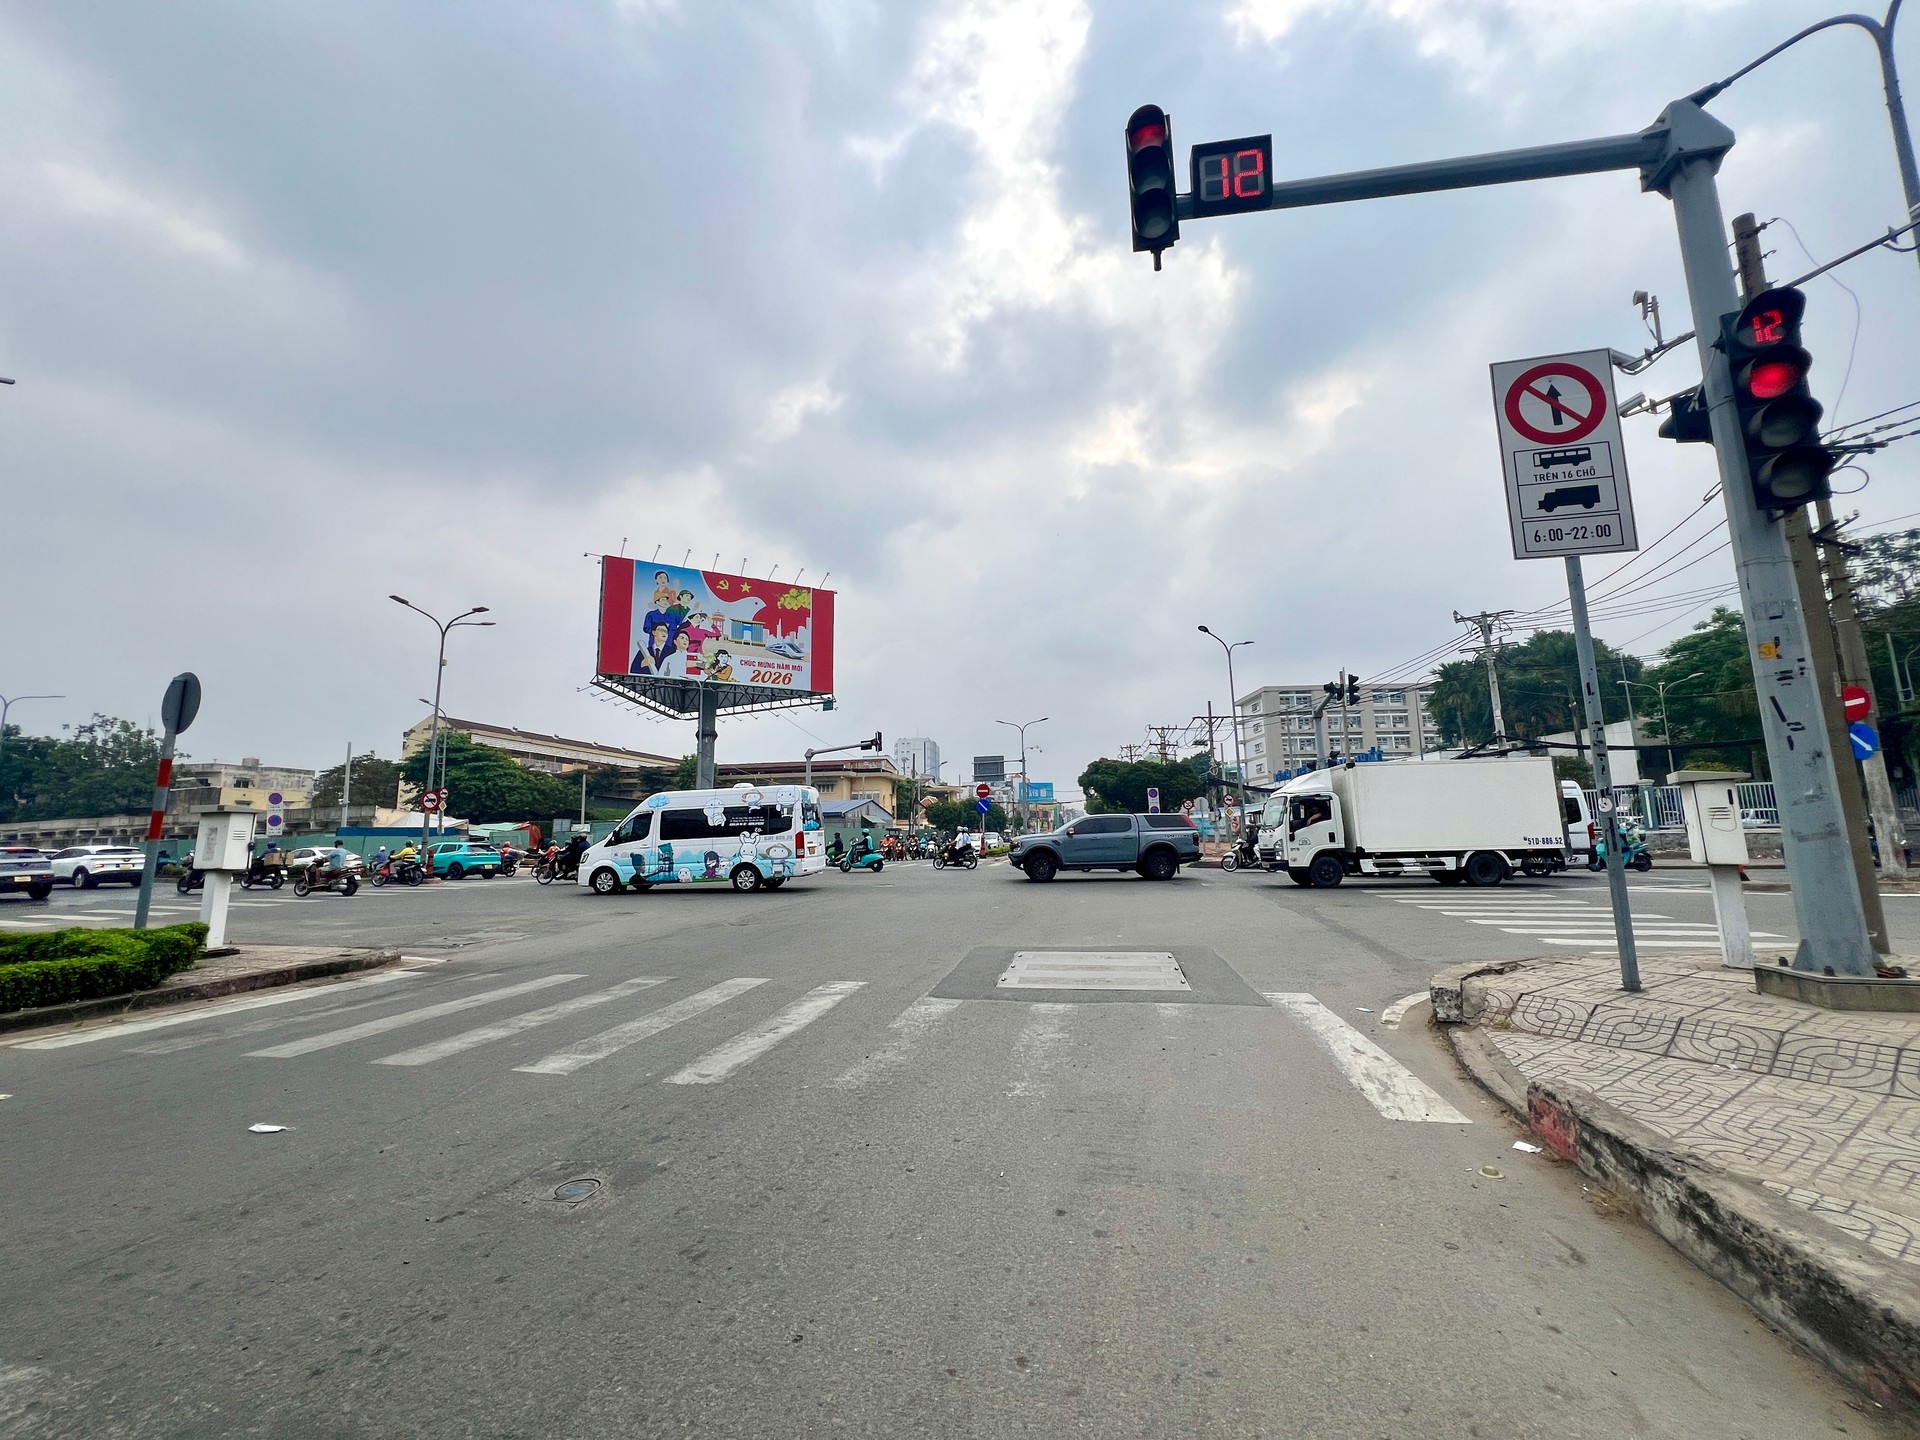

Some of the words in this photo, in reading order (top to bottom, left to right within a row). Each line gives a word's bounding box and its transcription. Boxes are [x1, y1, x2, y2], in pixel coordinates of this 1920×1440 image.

[1219, 149, 1264, 199] 12
[1752, 310, 1783, 343] 12
[1562, 470, 1573, 479] 16
[750, 669, 793, 685] 2026
